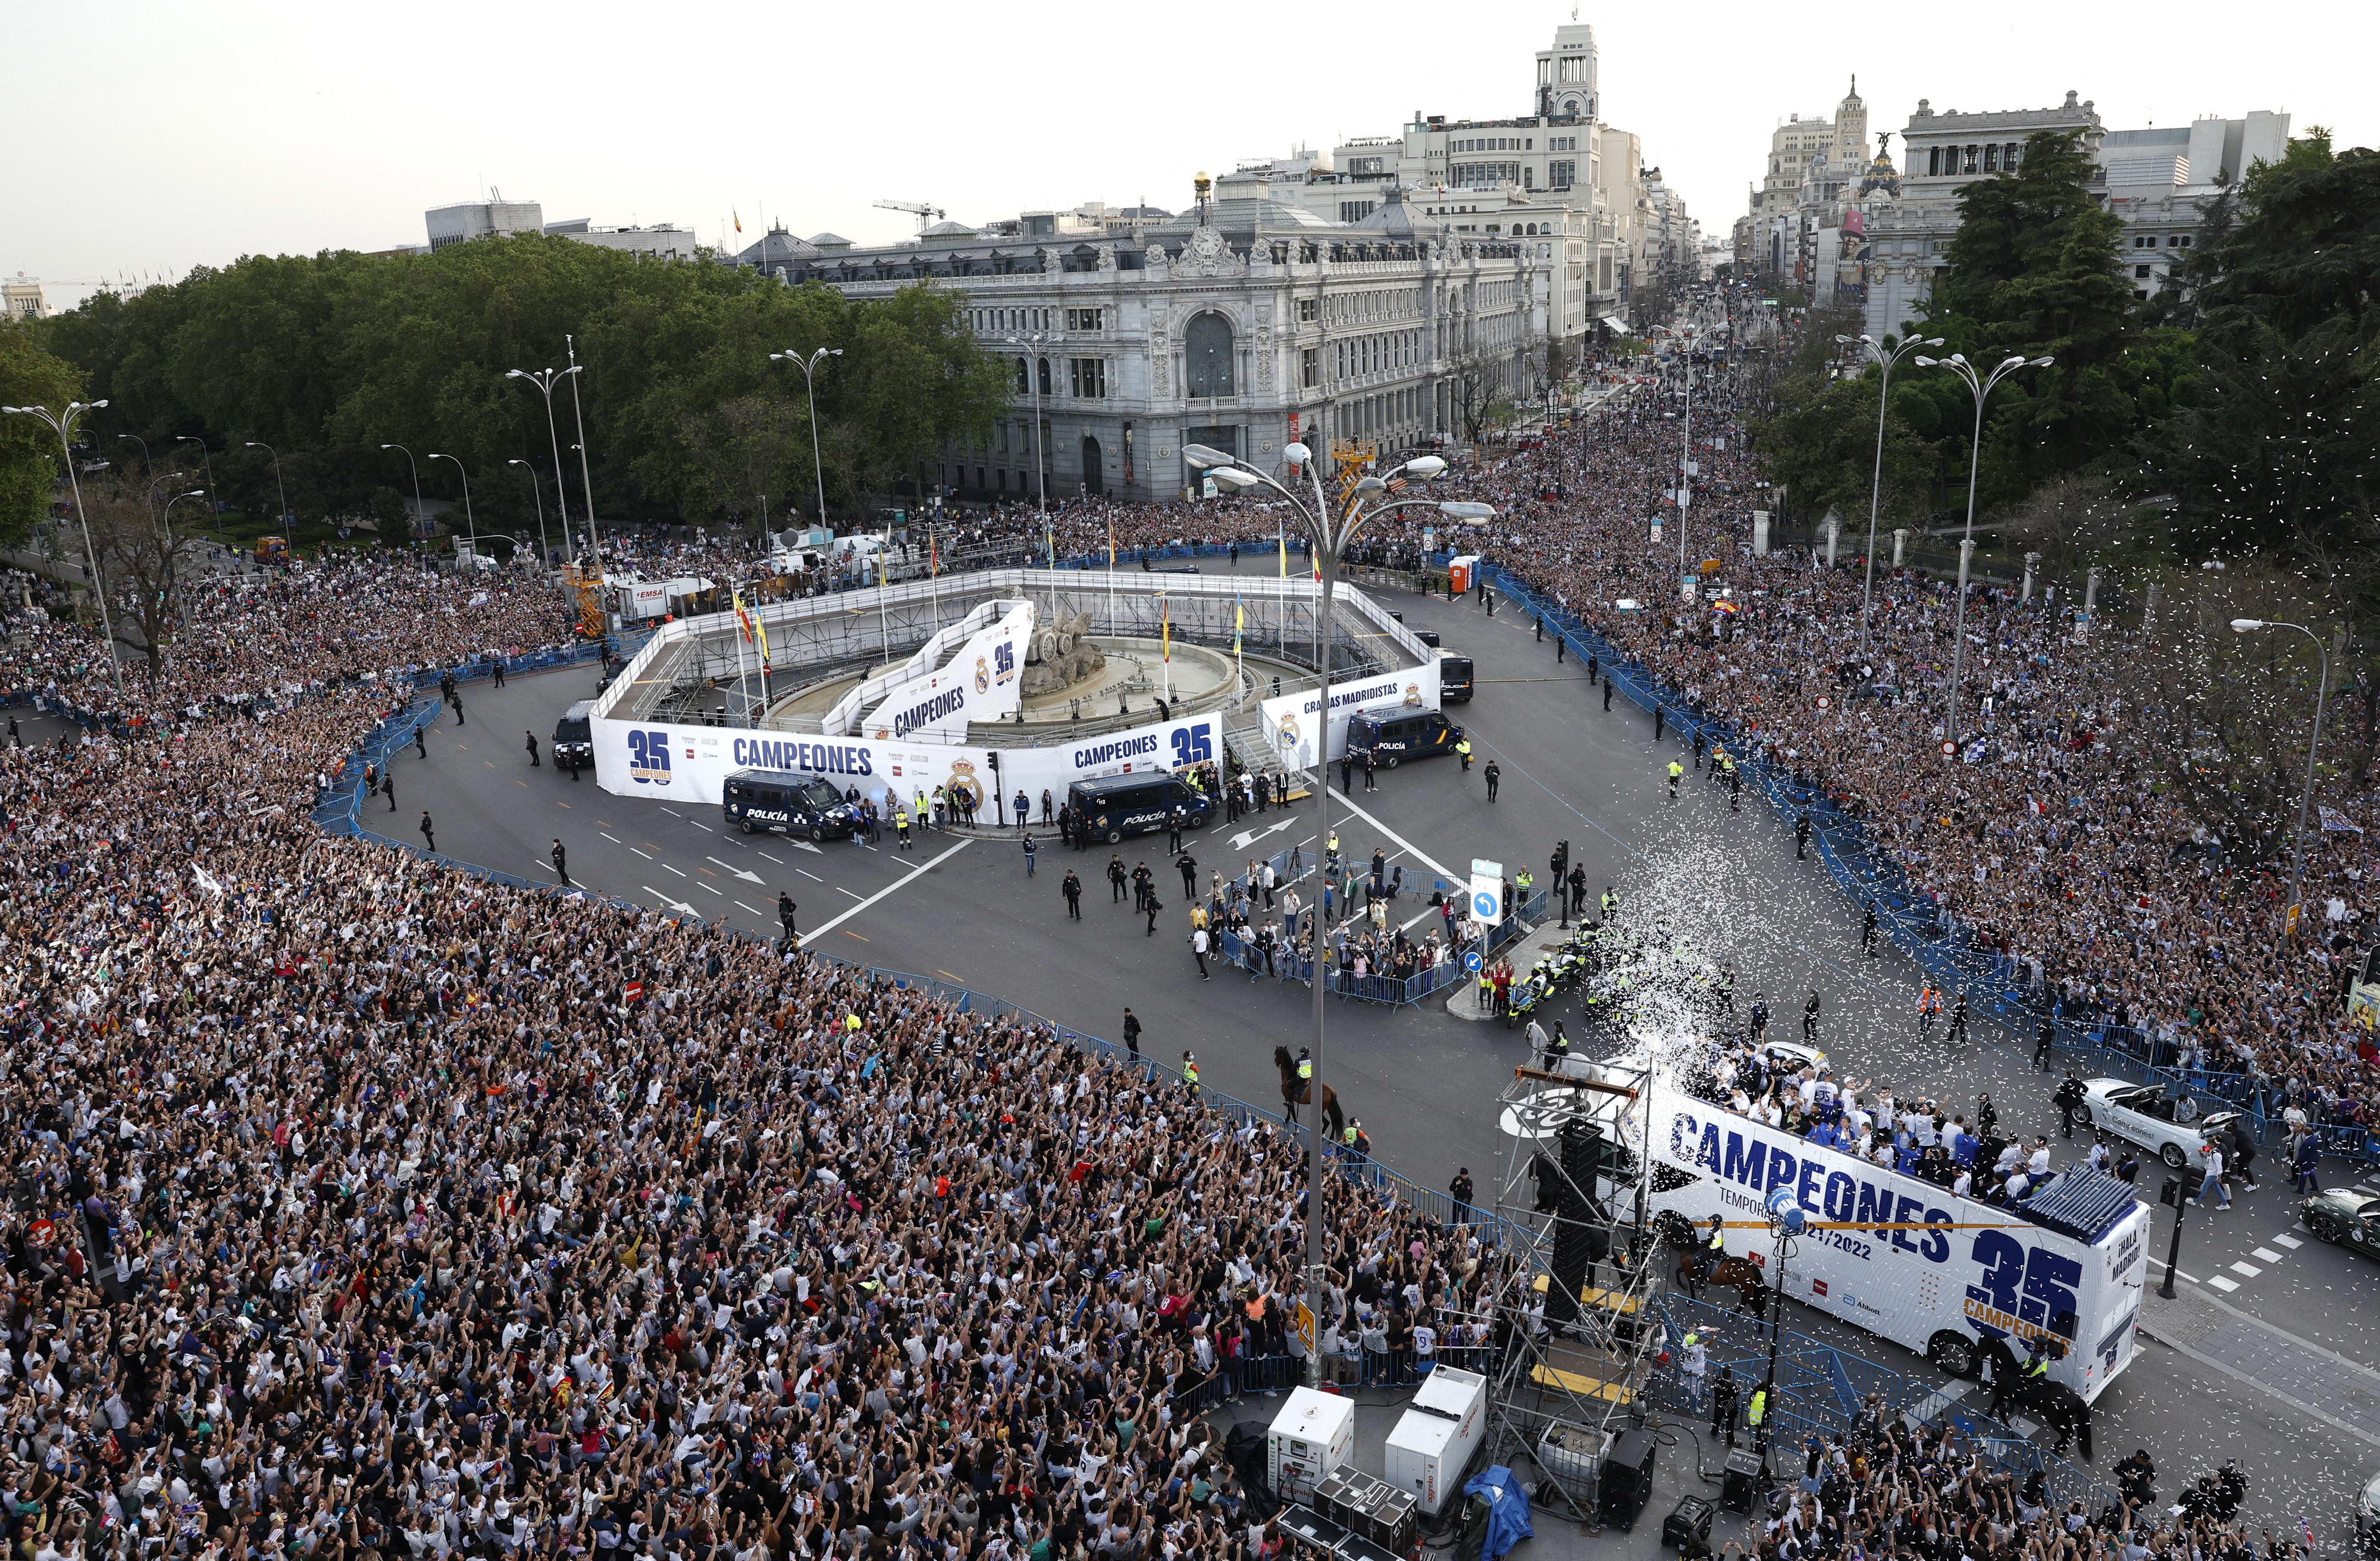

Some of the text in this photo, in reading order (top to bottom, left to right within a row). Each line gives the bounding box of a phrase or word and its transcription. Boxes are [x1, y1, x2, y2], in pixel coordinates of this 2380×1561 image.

[640, 589, 663, 598] EMSA
[995, 641, 1014, 686] 35
[995, 670, 1014, 682] CAMPEONES
[1304, 683, 1398, 714] GRAIAS MADRIDISTAS
[895, 686, 964, 738] CAMPEONES
[734, 738, 872, 776] CAMPEONES
[1075, 734, 1157, 768] CAMPEONES
[1171, 723, 1211, 768] 35
[1348, 743, 1371, 755] POLICÍA
[1378, 741, 1406, 750] POLICÍA
[628, 730, 671, 786] 35
[631, 768, 672, 780] CAMPEONES
[746, 808, 788, 822] POLICÍA
[1123, 811, 1166, 825] POLICÍA
[1819, 1090, 1830, 1102] 35
[2112, 1116, 2160, 1140] Campeones!
[1670, 1112, 1955, 1263] CAMPEONES
[2118, 1230, 2137, 1259] ¡HALA
[2112, 1243, 2141, 1282] MADRID!
[1160, 1296, 1171, 1310] 18
[1965, 1230, 2082, 1360] 35
[1857, 1302, 1881, 1316] Abbott
[1420, 1337, 1426, 1348] 9
[1460, 1404, 1479, 1438] aggreko
[1335, 1432, 1349, 1457] aggreko
[1081, 1460, 1086, 1473] 9
[1281, 1485, 1313, 1497] aggreko
[1427, 1475, 1435, 1503] aggreko
